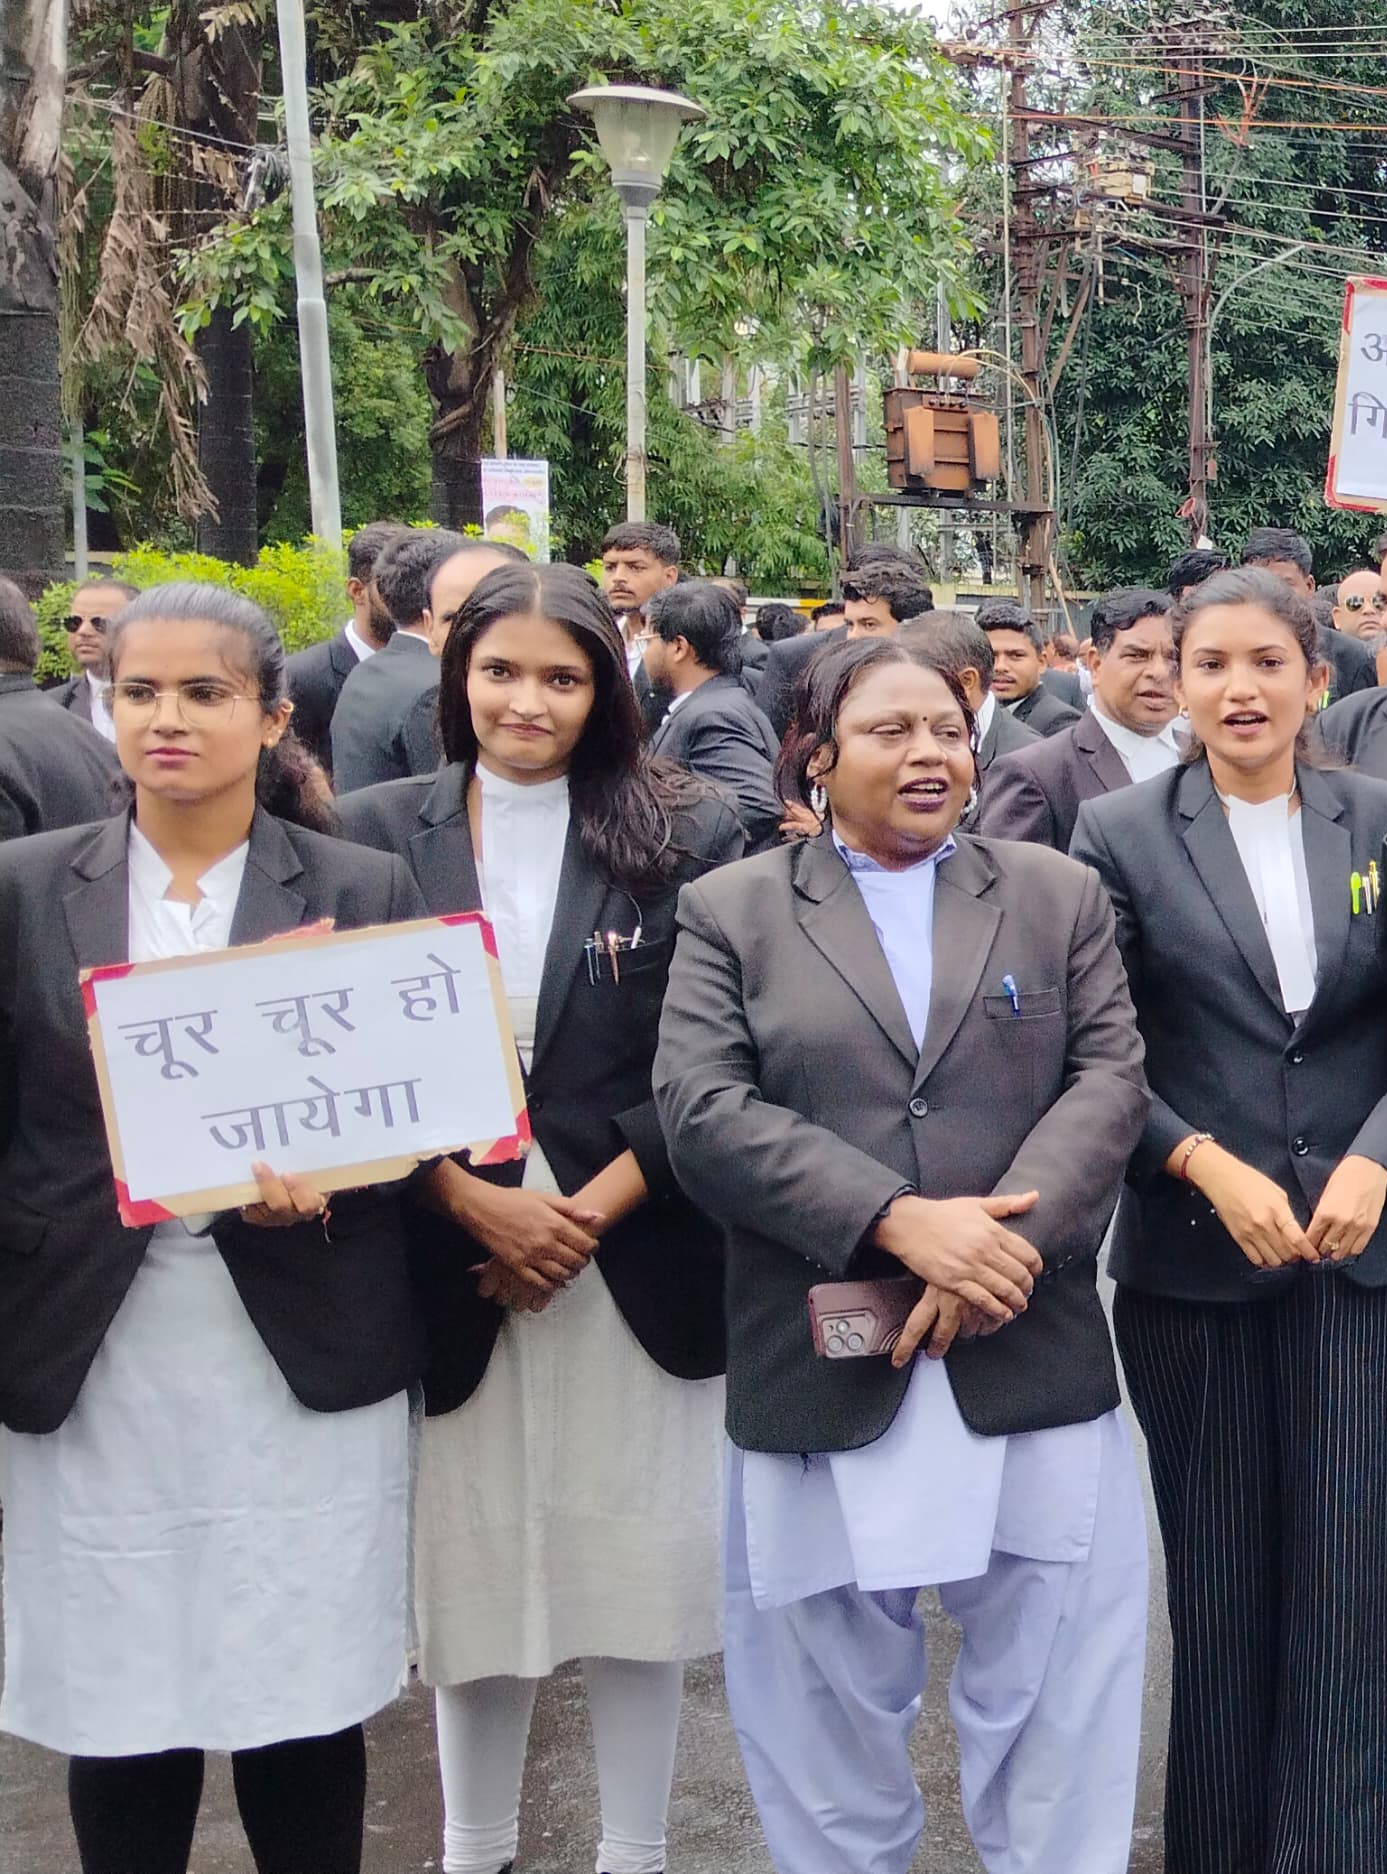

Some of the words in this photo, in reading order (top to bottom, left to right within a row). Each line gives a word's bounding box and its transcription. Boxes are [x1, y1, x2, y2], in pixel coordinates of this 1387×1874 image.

[118, 1009, 221, 1080] चूर
[255, 987, 356, 1057] चूर
[391, 953, 461, 1022] हो
[200, 1075, 422, 1151] जायेगा
